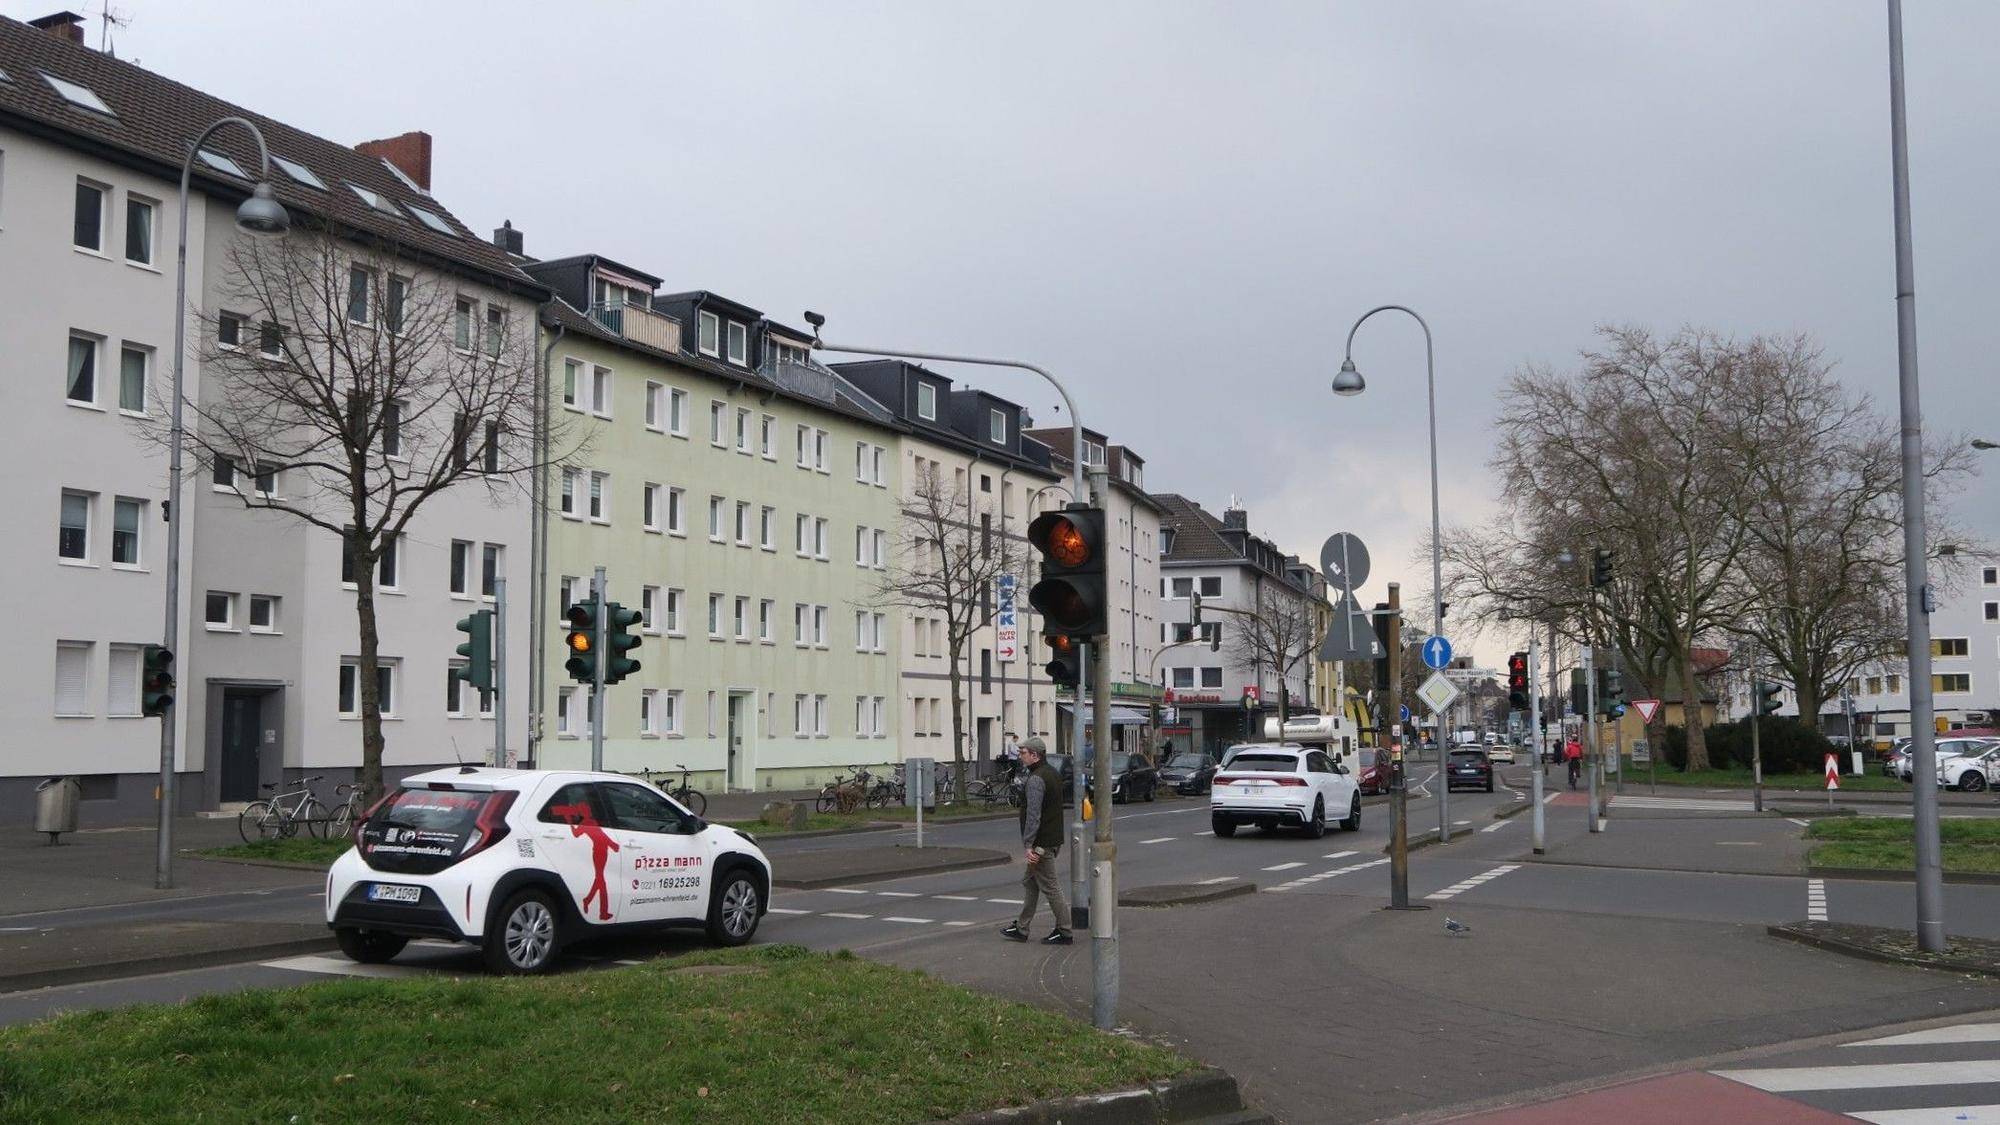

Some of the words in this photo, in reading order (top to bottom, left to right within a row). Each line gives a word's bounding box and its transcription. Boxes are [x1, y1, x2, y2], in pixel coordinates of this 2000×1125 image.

[1179, 694, 1220, 704] Sparkasse
[635, 856, 669, 870] pizza
[674, 857, 702, 866] mann
[659, 876, 700, 889] 16925298
